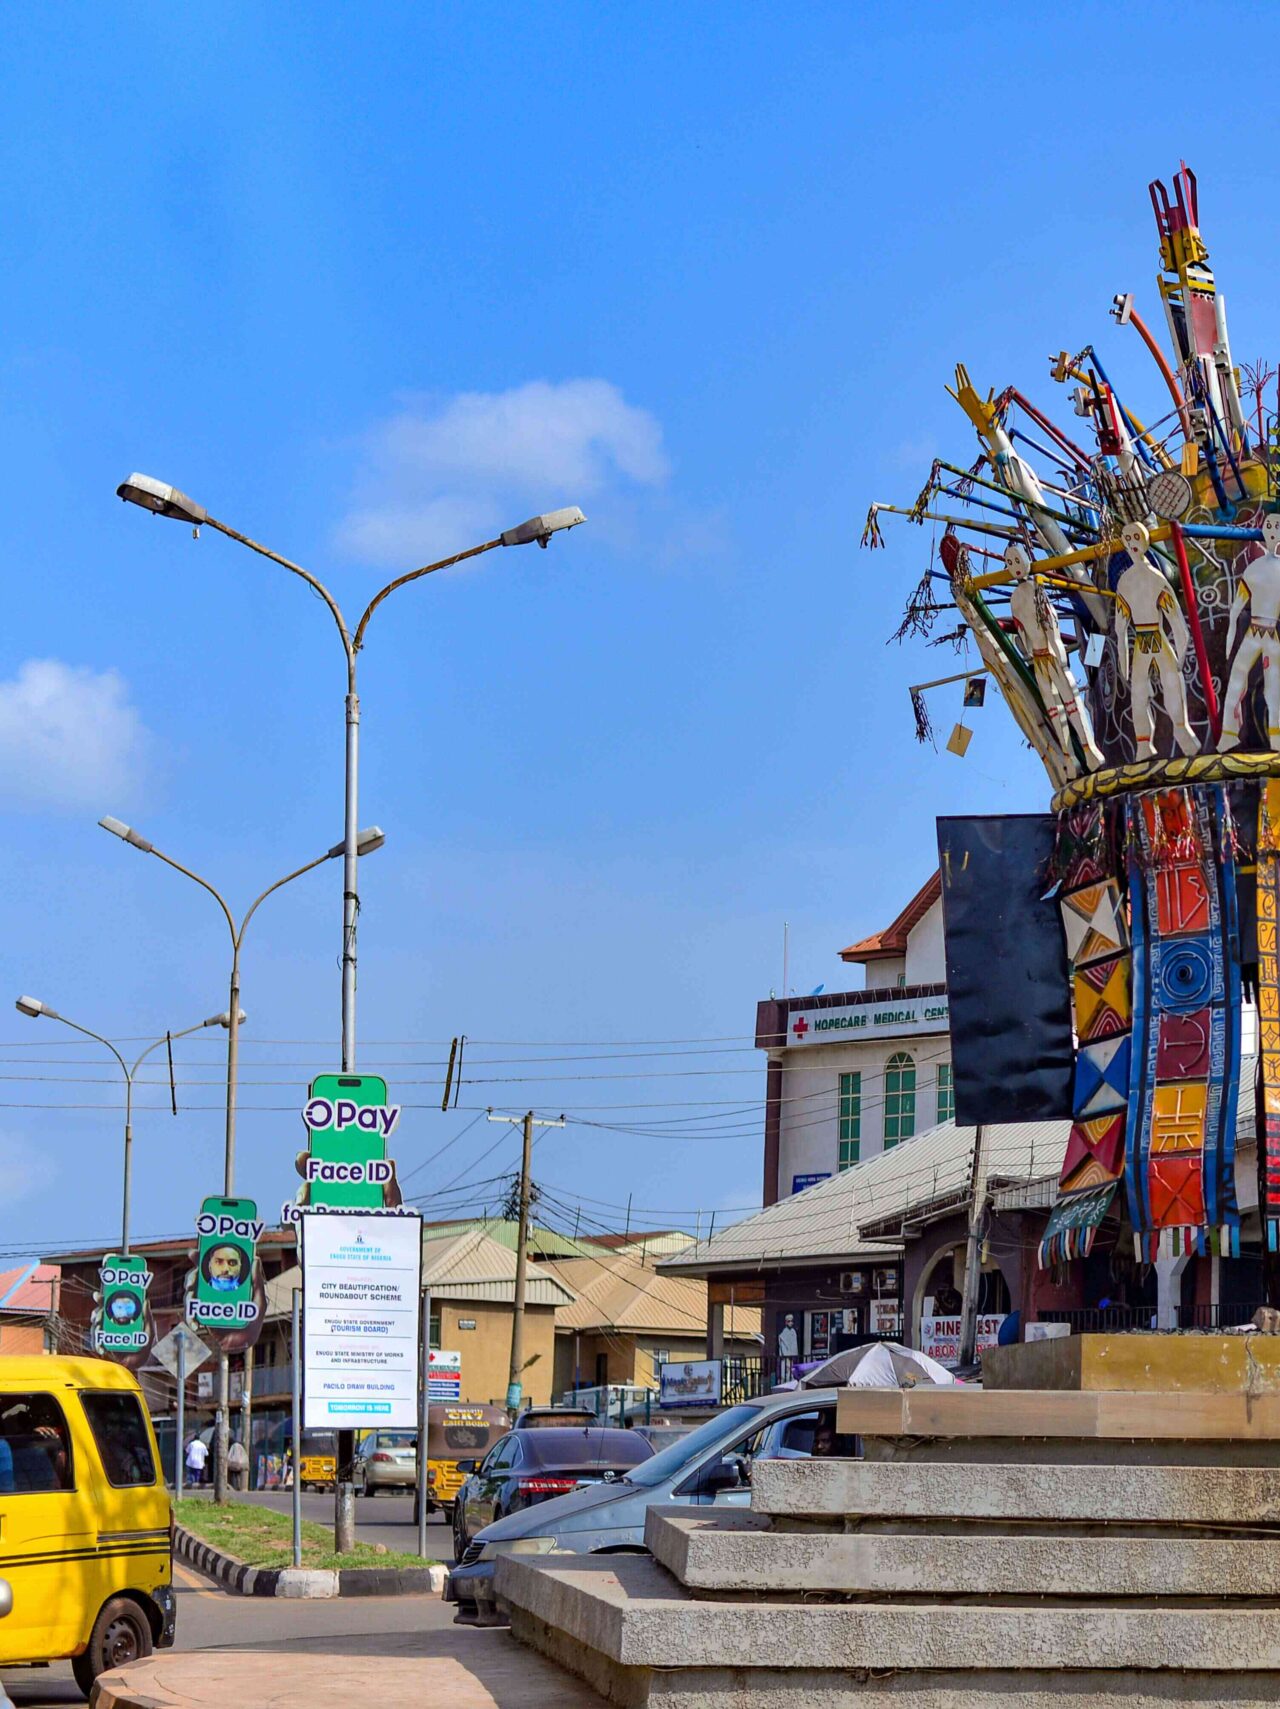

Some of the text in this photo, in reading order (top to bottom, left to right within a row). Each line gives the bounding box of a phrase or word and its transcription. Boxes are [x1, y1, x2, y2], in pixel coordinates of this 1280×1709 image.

[815, 1015, 866, 1031] HOPECARE
[874, 1010, 917, 1024] MEDICAL
[306, 1100, 398, 1134] OPay
[308, 1161, 390, 1182] Face ID
[283, 1204, 310, 1222] fo
[197, 1215, 264, 1240] OPay
[102, 1270, 150, 1286] OPay
[188, 1302, 257, 1318] Face ID
[96, 1332, 148, 1344] Face ID
